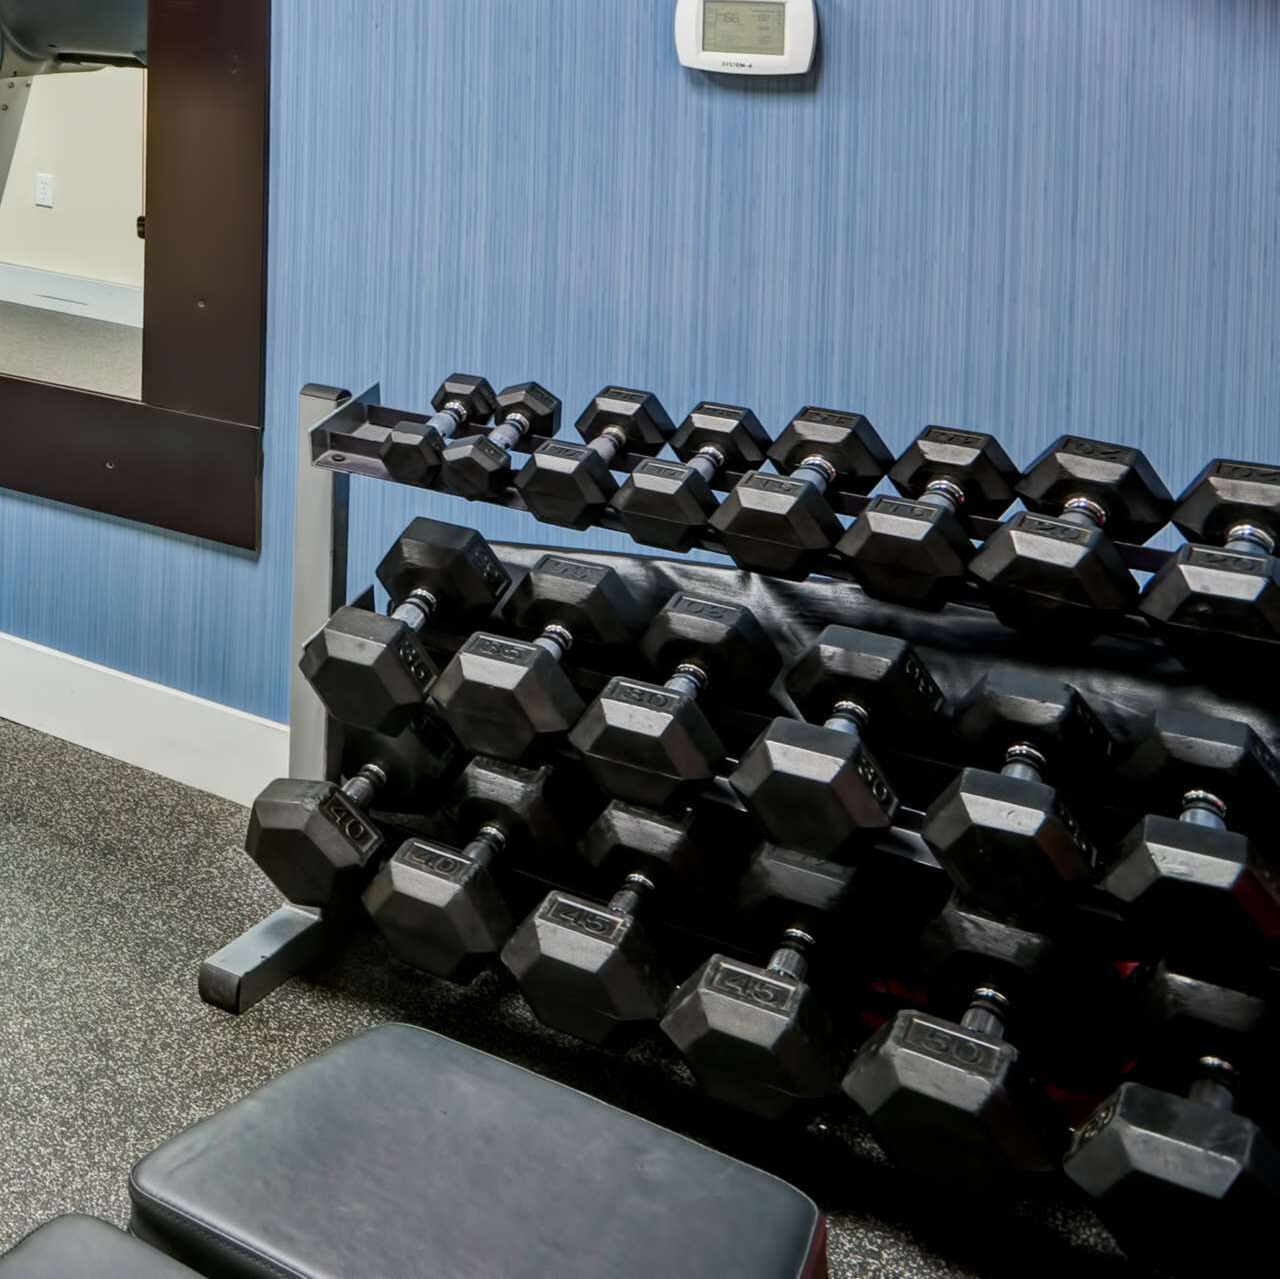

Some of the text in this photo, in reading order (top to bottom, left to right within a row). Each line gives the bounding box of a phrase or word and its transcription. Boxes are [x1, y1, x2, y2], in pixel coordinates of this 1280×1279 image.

[623, 686, 669, 708] 30
[331, 804, 365, 841] 40
[408, 847, 458, 874] 40
[559, 907, 610, 934] 45
[723, 973, 779, 1005] 45
[921, 1027, 985, 1065] 50
